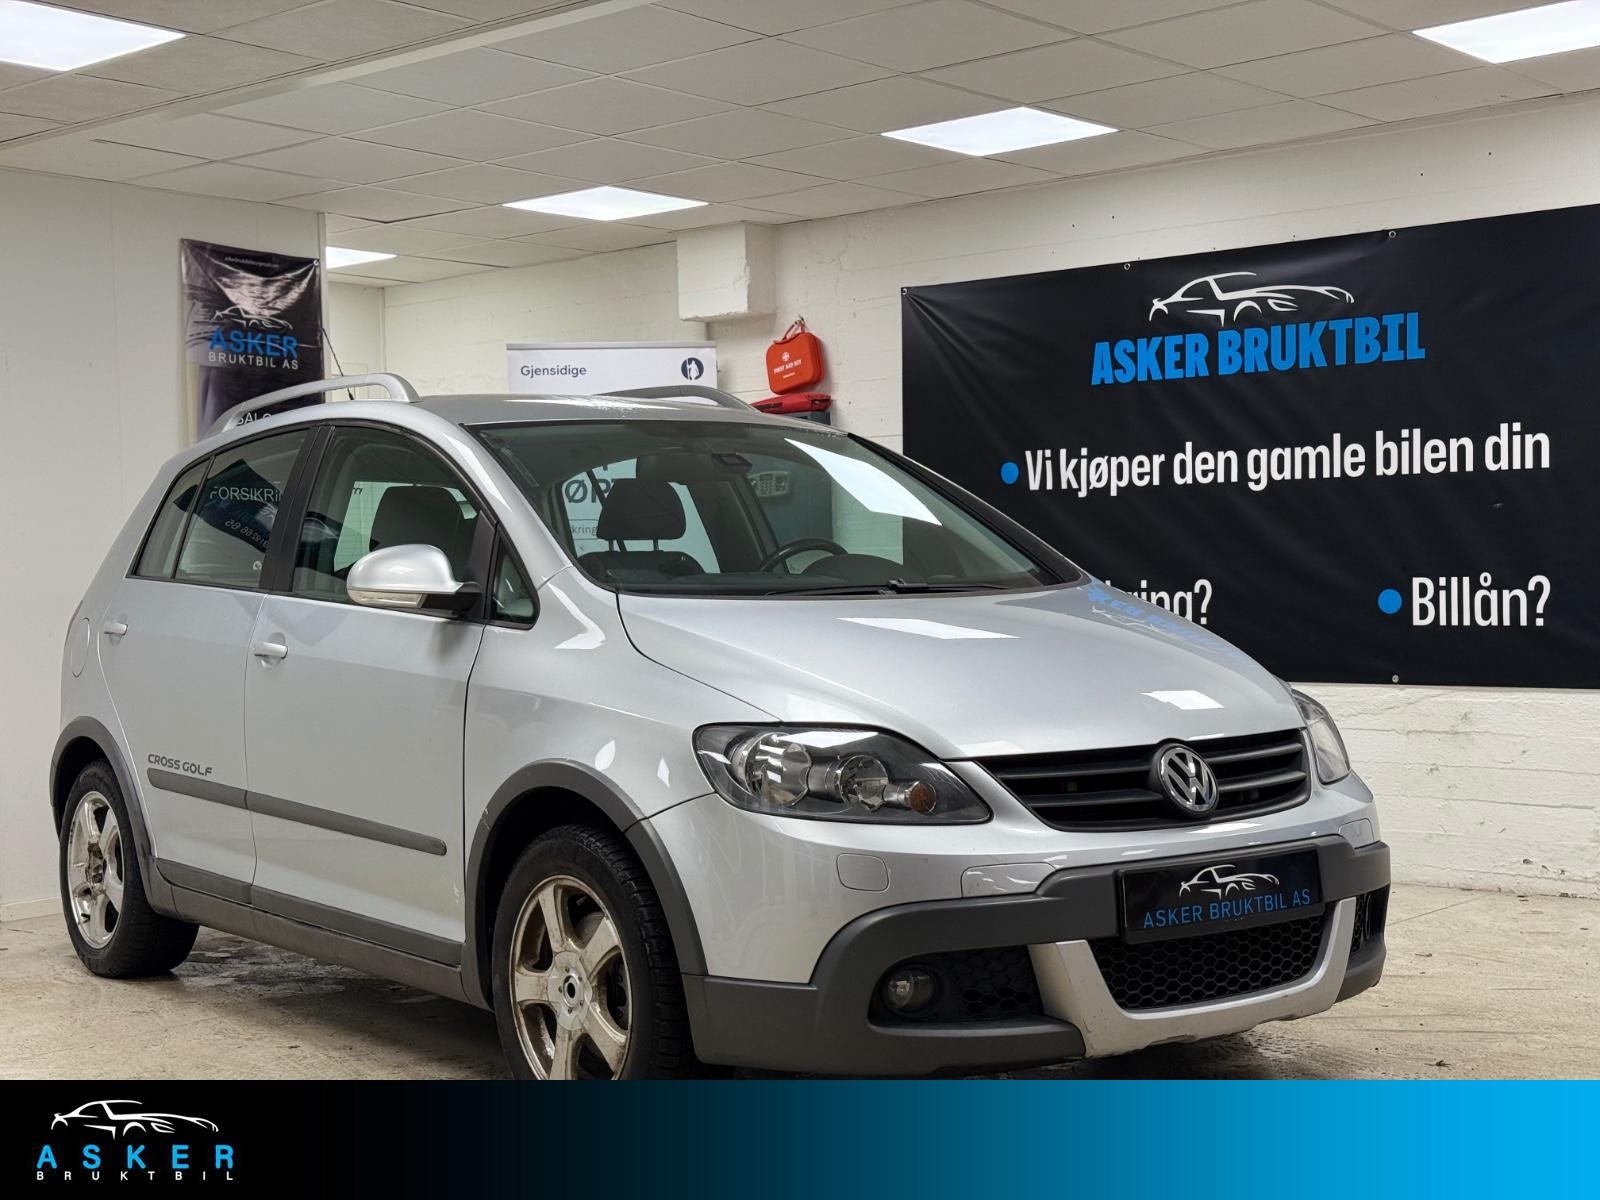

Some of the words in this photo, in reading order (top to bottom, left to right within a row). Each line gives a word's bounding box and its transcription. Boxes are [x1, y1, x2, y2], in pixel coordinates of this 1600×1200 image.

[208, 351, 276, 368] BRUKTBIL
[282, 359, 299, 370] AS
[209, 327, 298, 359] ASKER
[1091, 333, 1210, 386] ASKER
[1217, 312, 1426, 375] BRUKTBIL
[520, 364, 587, 379] Gjensidige
[1025, 449, 1053, 490] Vi
[1059, 447, 1166, 498] kjøper
[1173, 441, 1238, 485] den
[1246, 433, 1366, 491] gamle
[1375, 428, 1474, 476] bilen
[1484, 422, 1551, 471] din
[1411, 573, 1551, 627] Billån?
[147, 753, 181, 770] CROSS
[182, 761, 213, 777] GOLF
[1143, 905, 1203, 929] ASKER
[1209, 892, 1288, 920] BRUKTBIL
[1292, 888, 1311, 906] AS
